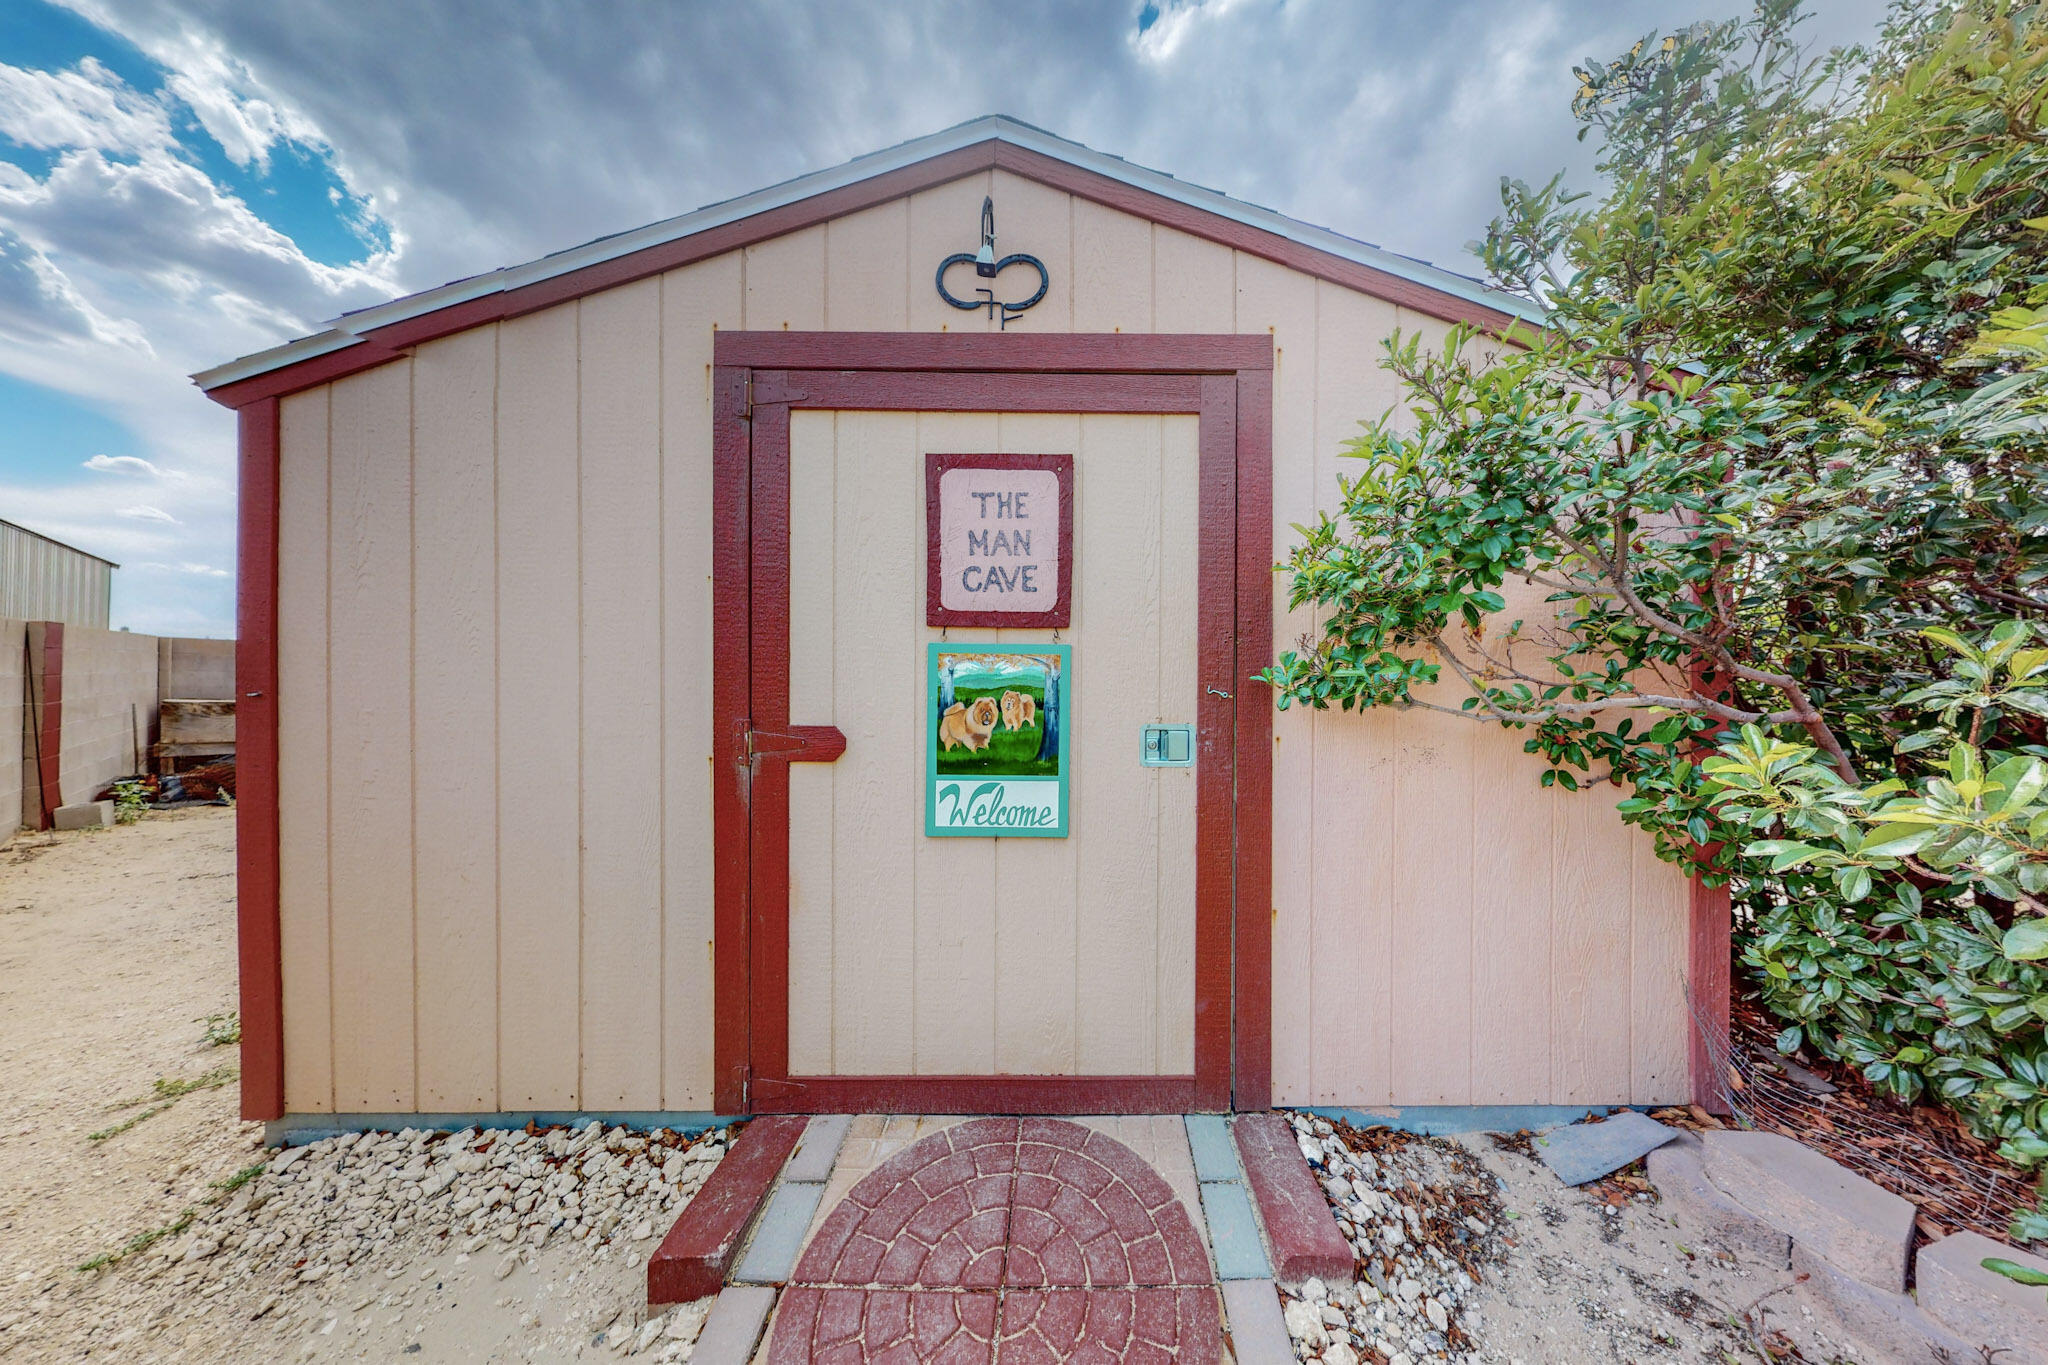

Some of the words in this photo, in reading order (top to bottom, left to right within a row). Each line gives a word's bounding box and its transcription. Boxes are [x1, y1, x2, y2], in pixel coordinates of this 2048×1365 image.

[971, 492, 1029, 519] THE
[967, 529, 1032, 556] MAN
[962, 565, 1038, 592] CAVE
[939, 782, 1056, 826] Welcome
